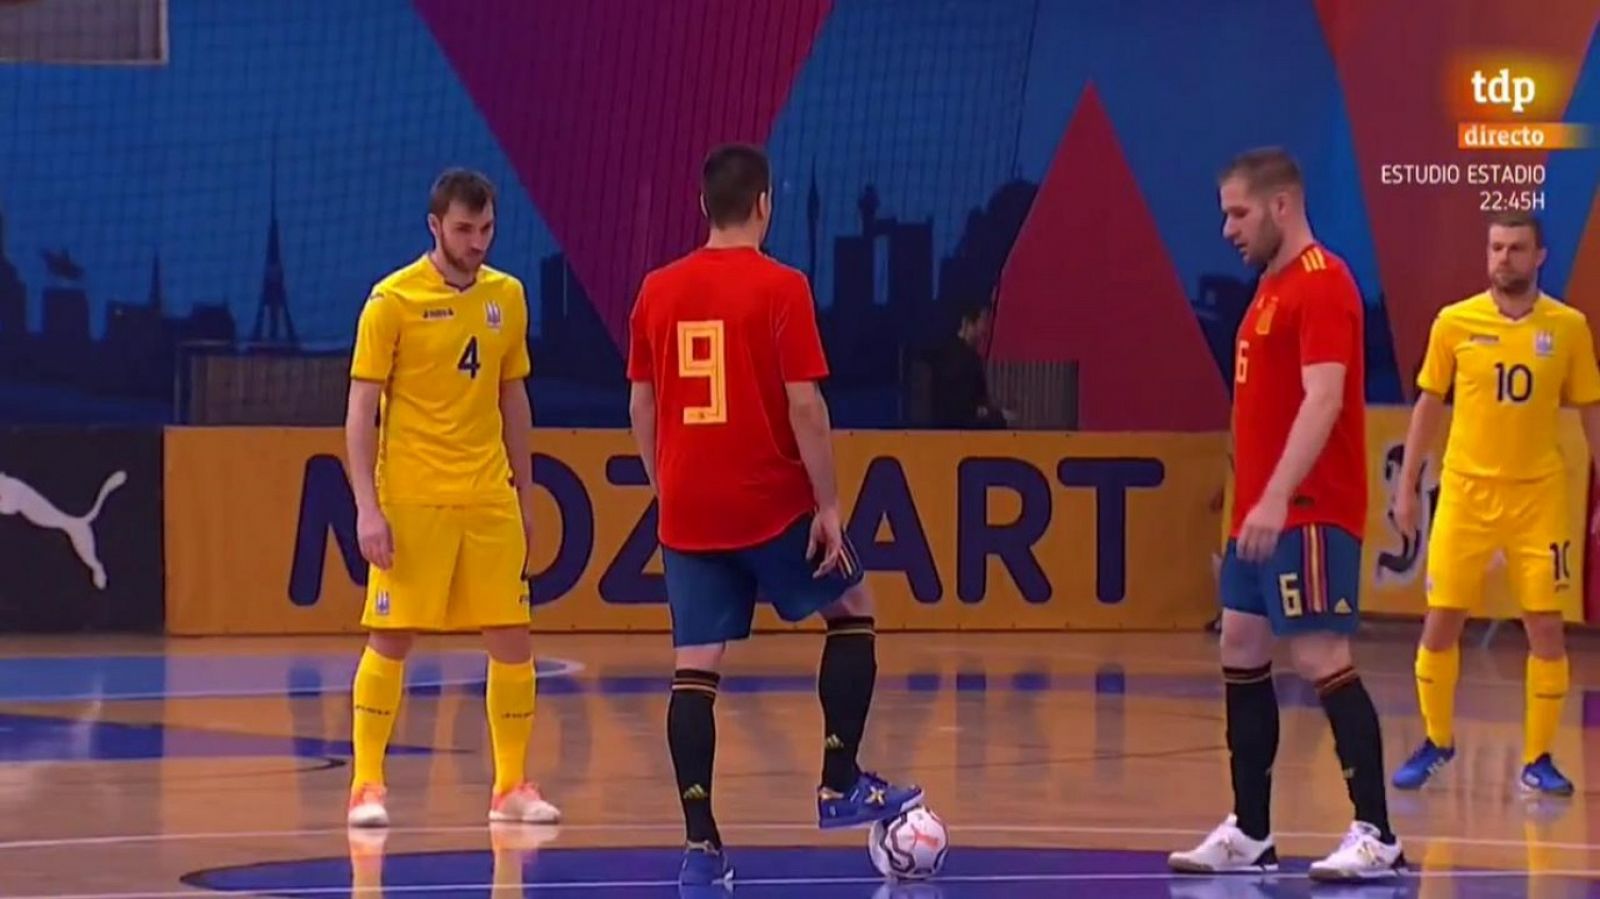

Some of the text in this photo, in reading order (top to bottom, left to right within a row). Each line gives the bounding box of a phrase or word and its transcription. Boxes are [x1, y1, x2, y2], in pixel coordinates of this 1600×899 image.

[457, 335, 481, 380] 4
[677, 319, 727, 425] 9
[1494, 362, 1533, 403] 10
[288, 452, 1165, 605] MZART
[1279, 572, 1303, 617] 6
